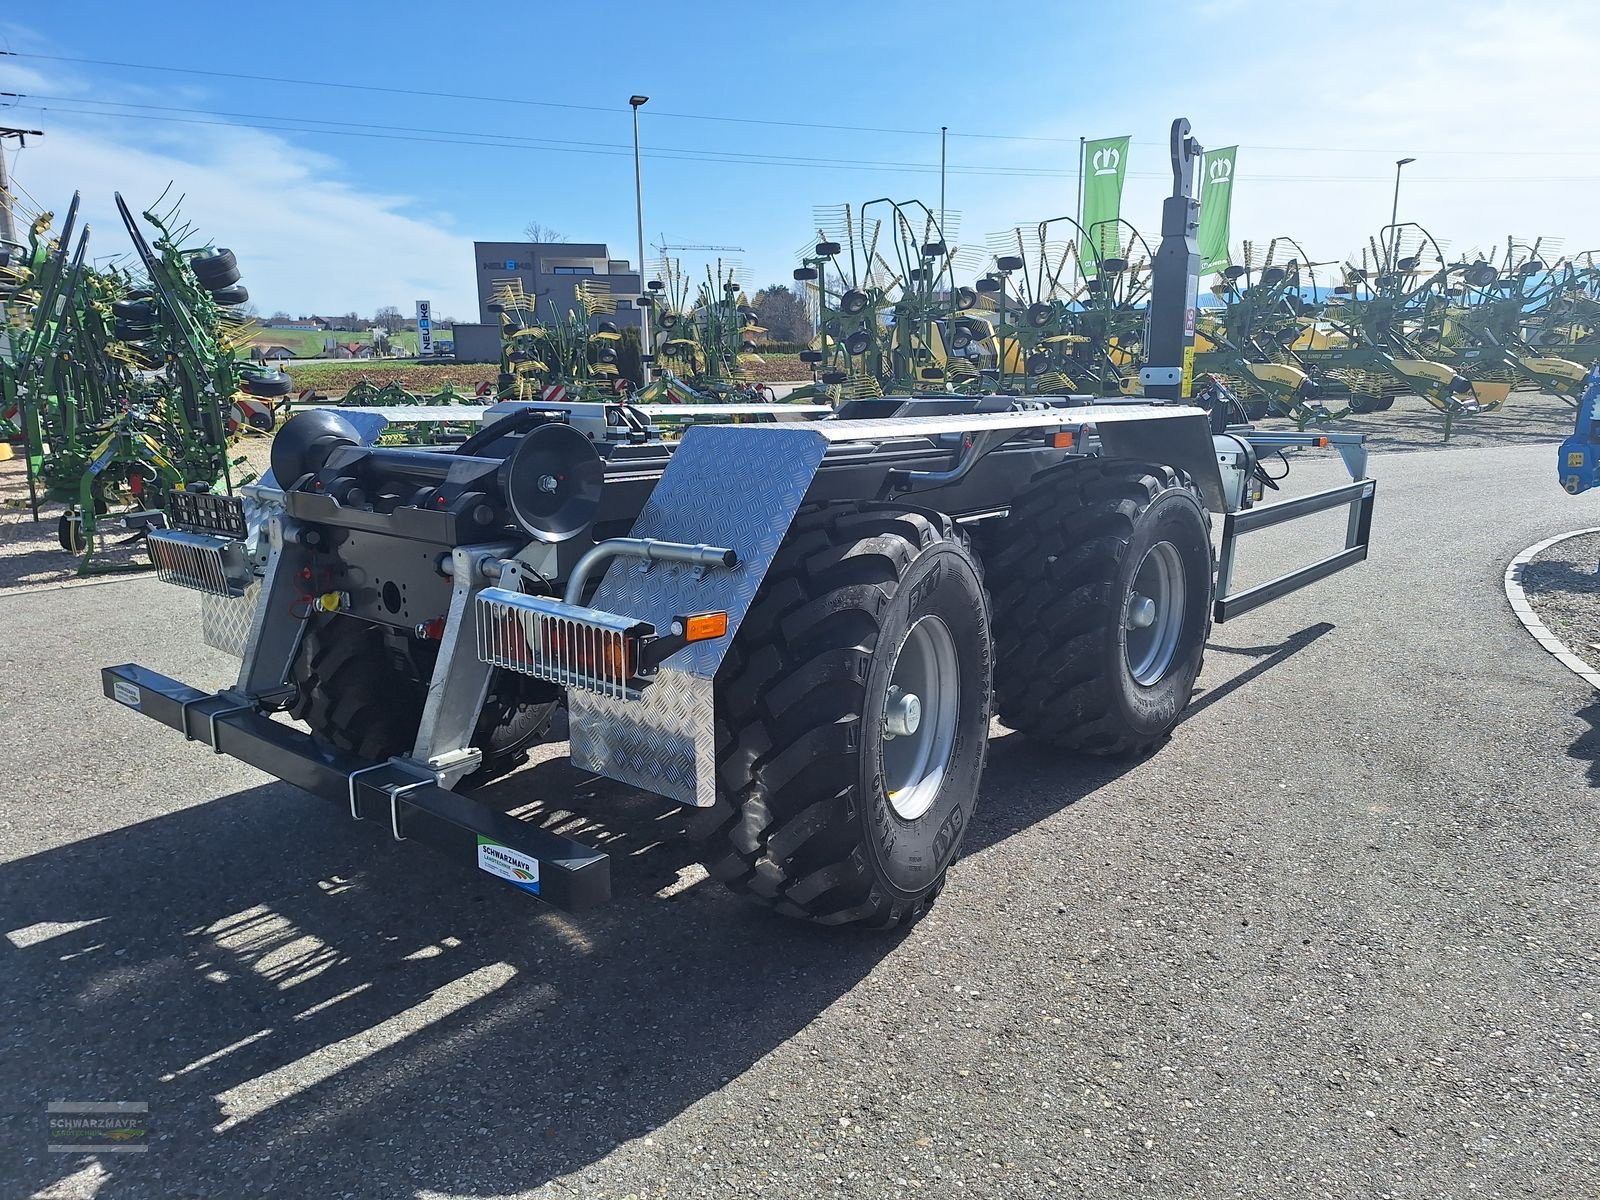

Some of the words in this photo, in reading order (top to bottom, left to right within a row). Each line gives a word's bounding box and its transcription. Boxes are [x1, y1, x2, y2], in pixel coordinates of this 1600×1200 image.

[910, 566, 941, 608] BKT
[935, 808, 962, 860] BKT
[482, 846, 530, 872] SCHWARZMAYR
[483, 855, 511, 870] LANDTECHNIK
